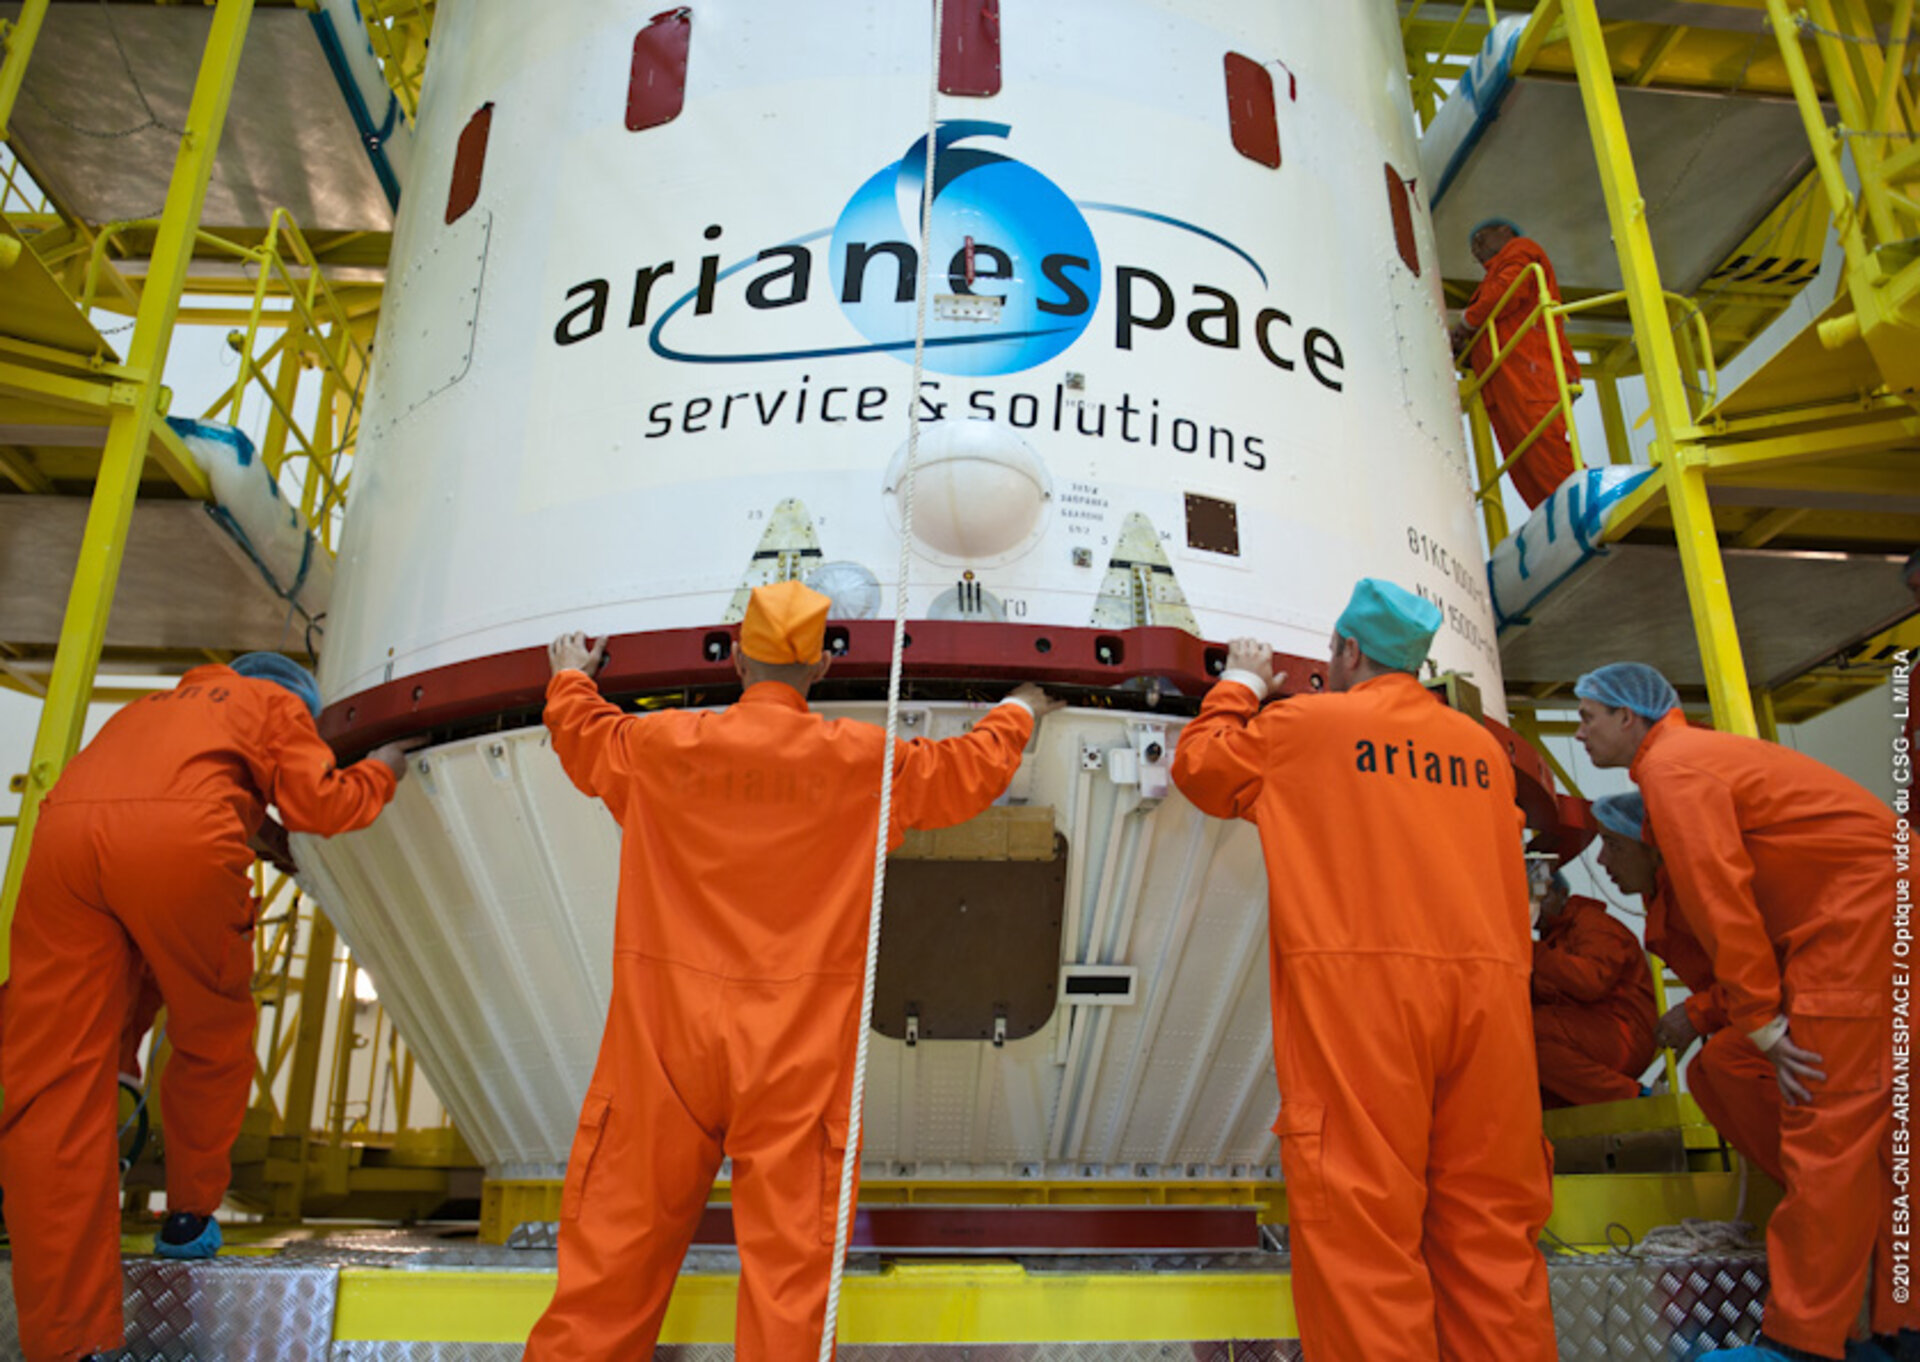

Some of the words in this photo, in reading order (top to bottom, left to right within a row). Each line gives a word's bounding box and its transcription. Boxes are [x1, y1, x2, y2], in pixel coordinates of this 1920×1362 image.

[553, 224, 1345, 393] arianespace
[645, 375, 887, 439] service
[909, 381, 948, 423] &
[968, 383, 1267, 472] solutions
[1354, 738, 1491, 790] ariane
